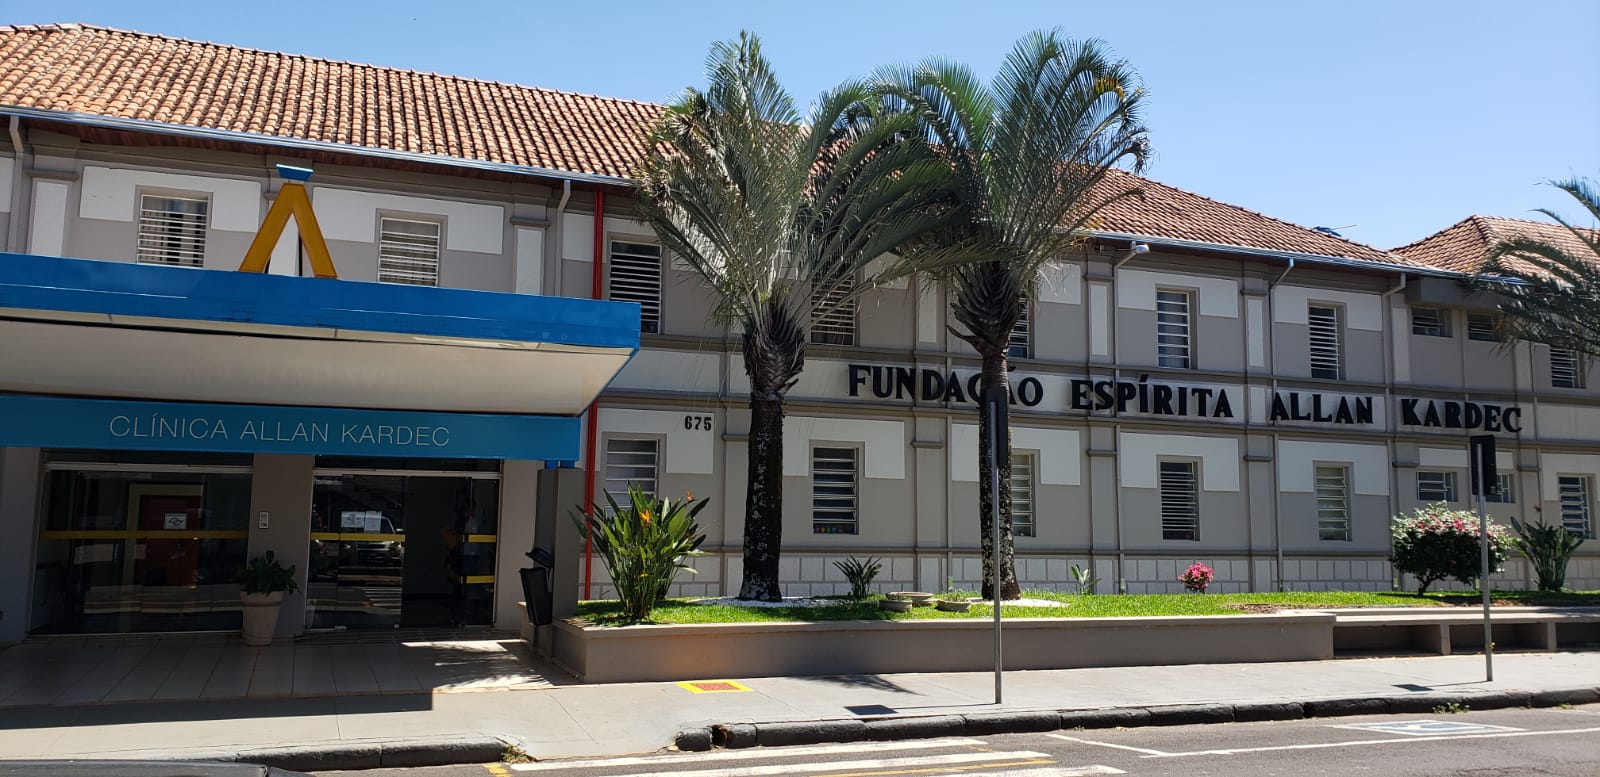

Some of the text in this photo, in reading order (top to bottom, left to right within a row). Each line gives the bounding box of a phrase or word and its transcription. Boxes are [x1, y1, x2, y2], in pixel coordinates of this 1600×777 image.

[1070, 373, 1234, 420] ESPÍRITA
[1269, 391, 1374, 425] ALLAN
[1400, 397, 1523, 433] KARDEC
[109, 413, 450, 447] CLÍNICA ALLAN KARDEC
[684, 415, 712, 431] 675
